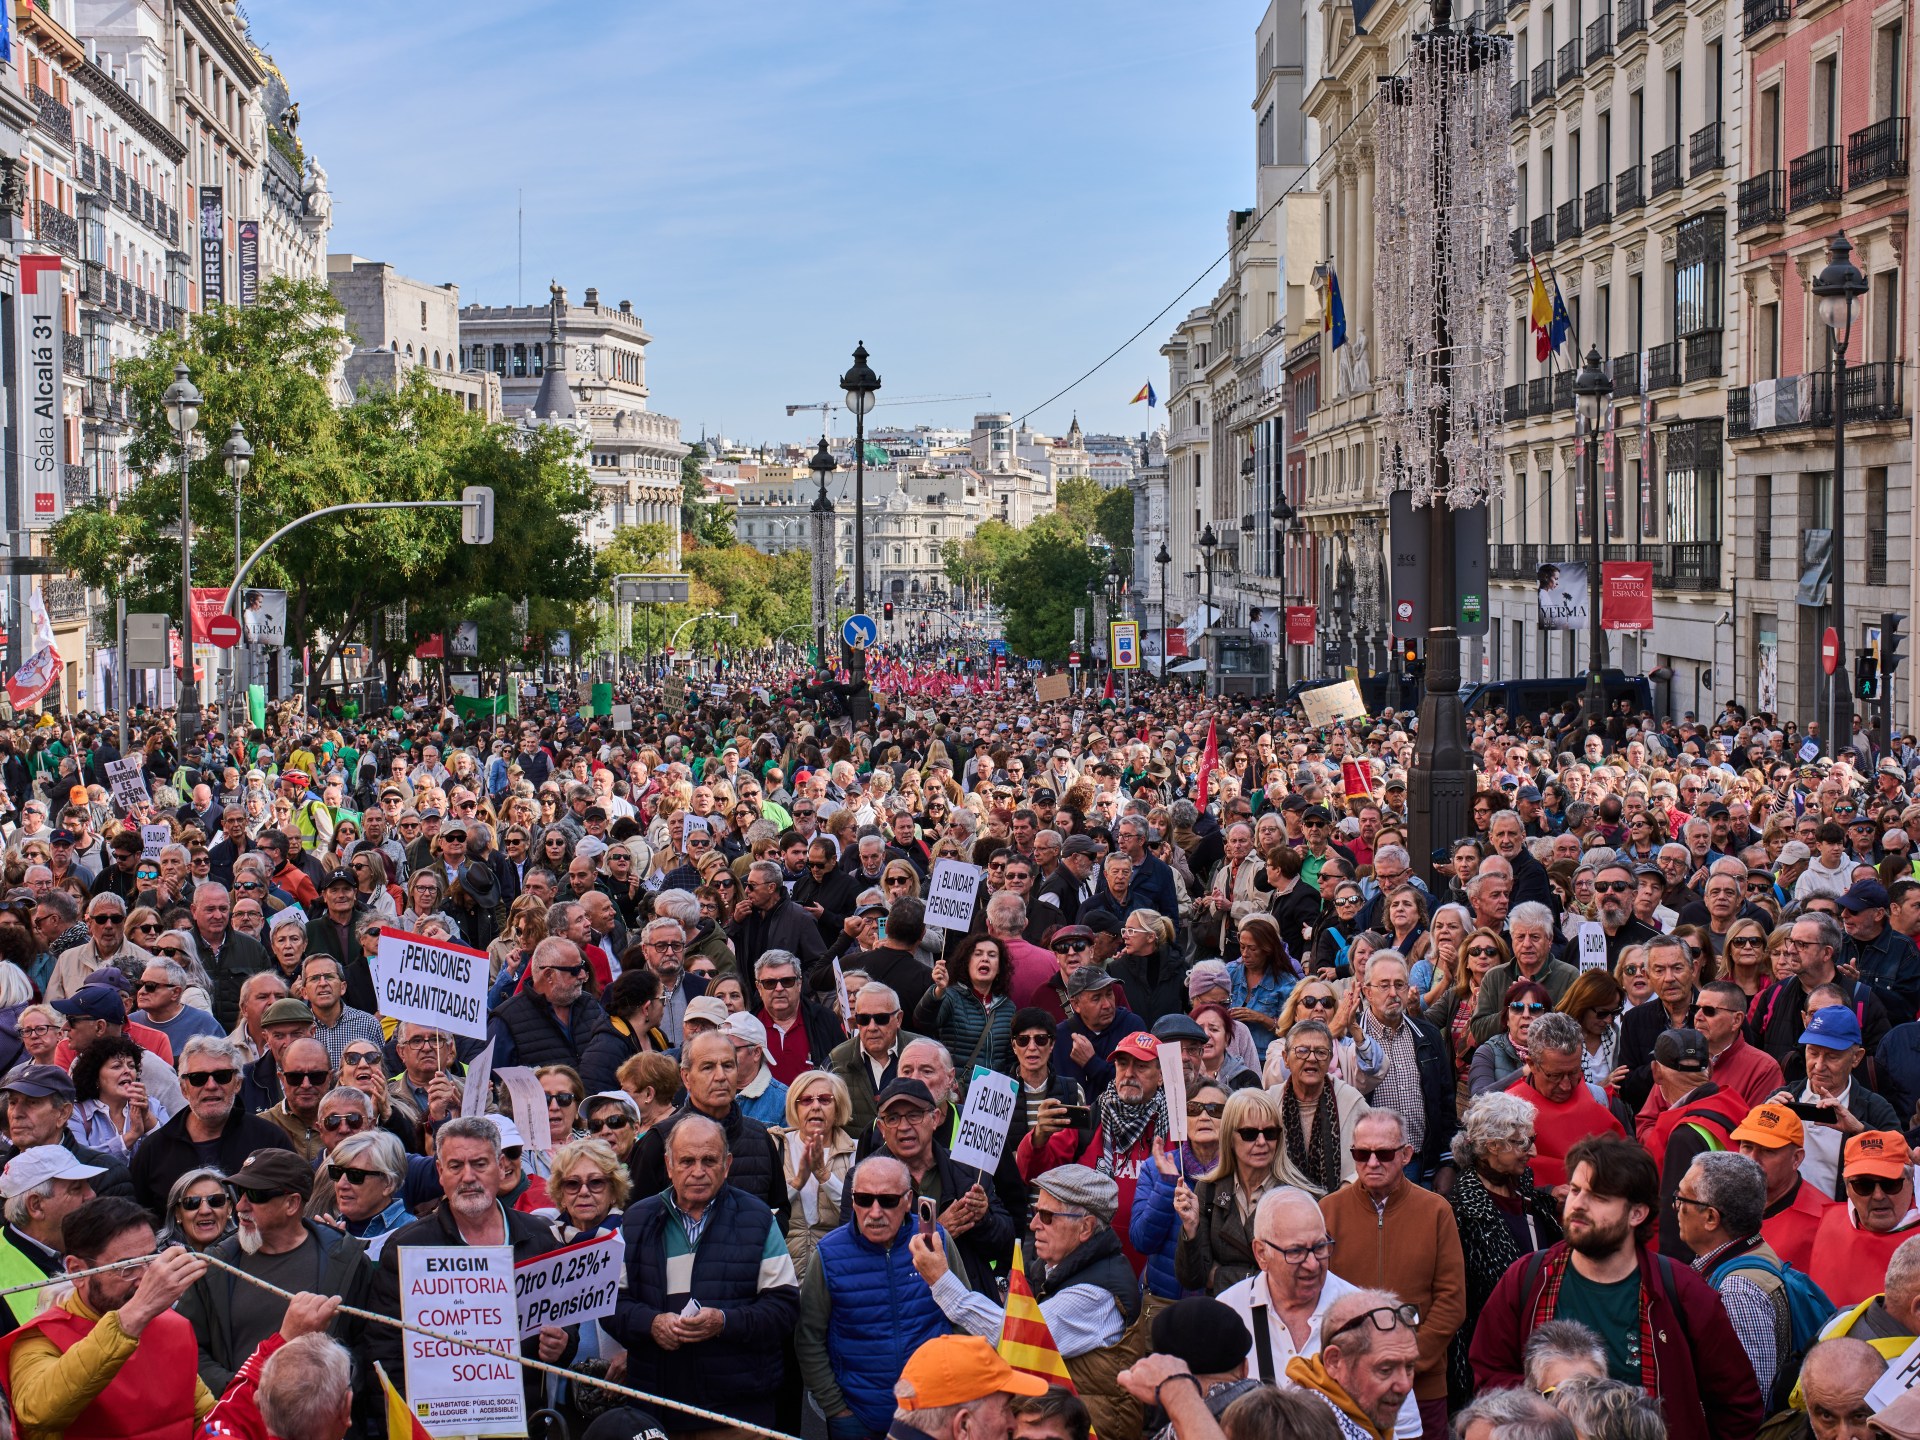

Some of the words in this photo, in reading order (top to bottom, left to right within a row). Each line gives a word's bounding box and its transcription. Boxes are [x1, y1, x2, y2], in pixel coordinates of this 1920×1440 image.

[242, 240, 257, 266] VIVAS
[32, 315, 53, 340] 31
[31, 347, 54, 420] Alcalá
[34, 426, 55, 472] Sala
[1611, 582, 1644, 590] TEATRO
[1612, 589, 1648, 598] ESPAÑOL
[197, 610, 222, 618] ESPAÑ
[1541, 605, 1587, 619] YERMA
[245, 623, 284, 635] YERMA
[1251, 631, 1278, 639] YERMA
[113, 760, 126, 772] LA
[108, 767, 140, 785] PENSIÓN
[121, 780, 133, 791] ES
[129, 795, 141, 804] DA
[142, 846, 162, 857] PENSION
[928, 895, 973, 921] PENSIONES!
[400, 943, 472, 984] ¡PENSIONES
[386, 977, 480, 1024] GARANTIZADAS!
[1760, 1110, 1780, 1122] MAREA
[1860, 1138, 1884, 1147] MAREA
[426, 1257, 489, 1272] EXIGIM
[411, 1277, 508, 1295] AUDITORIA
[515, 1271, 547, 1299] Otro
[526, 1280, 616, 1328] PPensión?
[418, 1308, 502, 1327] COMPTES
[413, 1338, 515, 1359] SEGURETAT
[452, 1363, 515, 1382] SOCIAL
[430, 1400, 471, 1409] L'HABITATGE:
[497, 1398, 518, 1406] SOCIAL
[439, 1409, 468, 1417] LLOGUER
[480, 1406, 514, 1414] ACCESSIBLE
